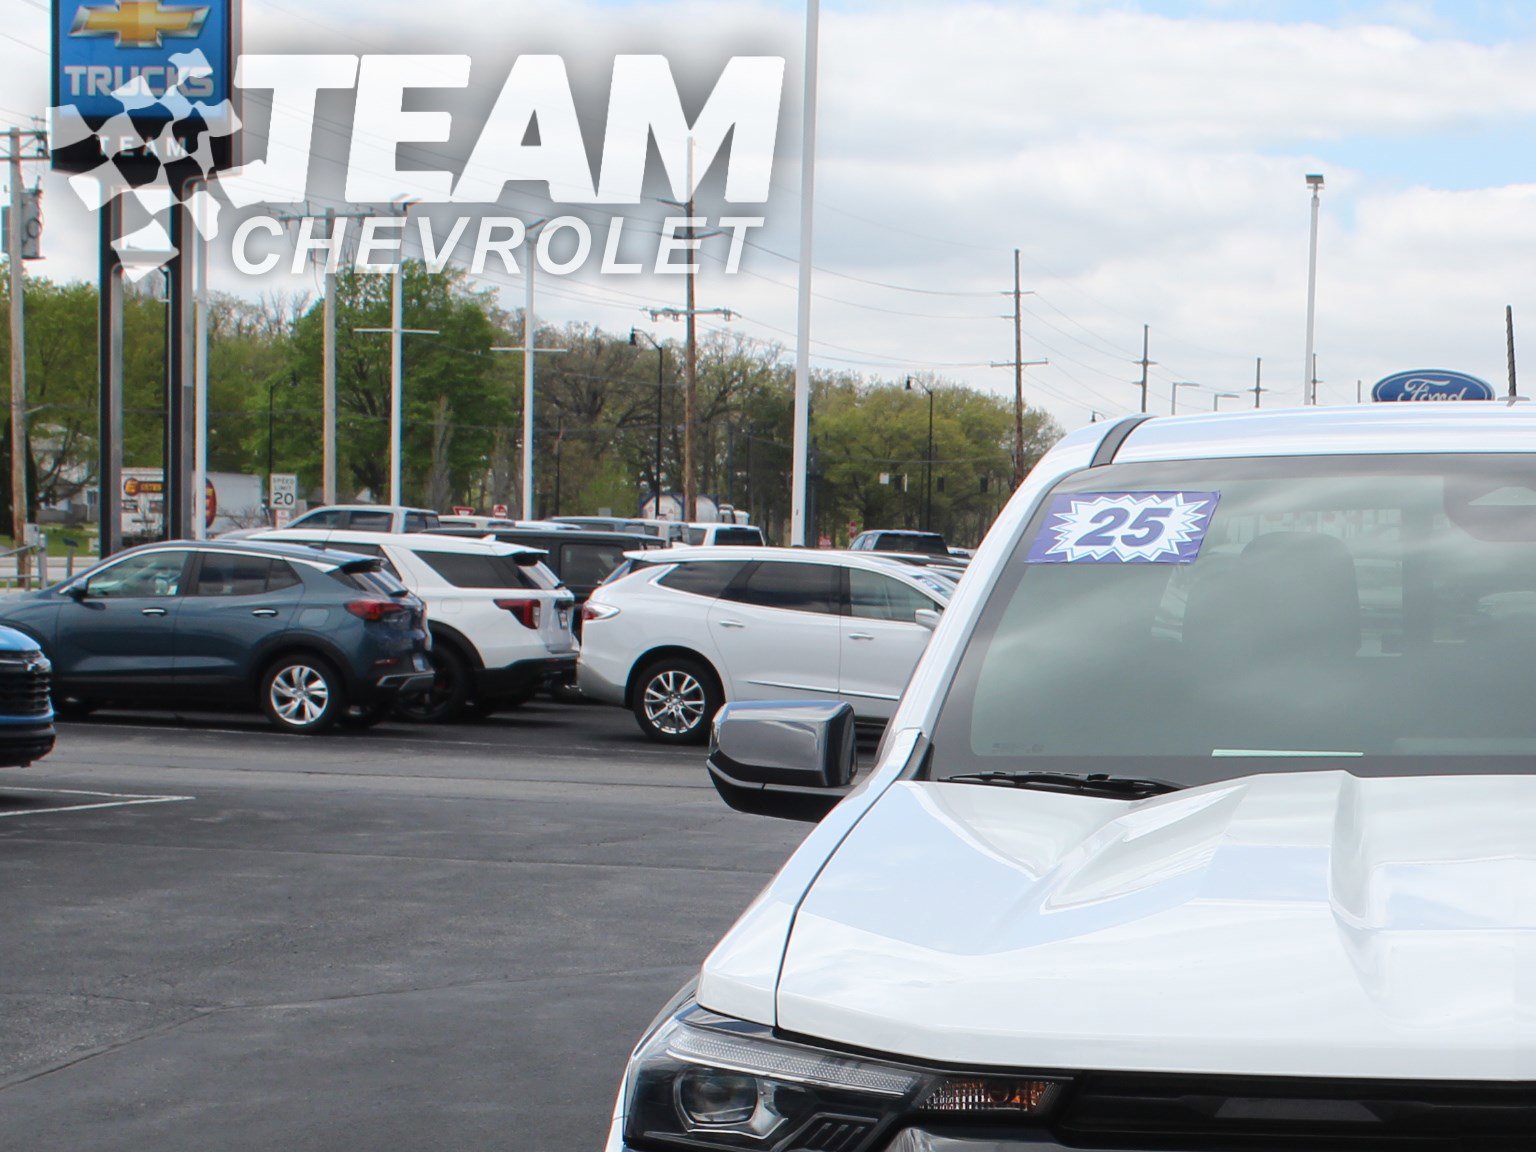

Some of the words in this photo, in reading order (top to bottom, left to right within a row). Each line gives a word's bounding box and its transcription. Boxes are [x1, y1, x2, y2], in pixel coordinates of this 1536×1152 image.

[64, 65, 215, 97] TRUCKS
[97, 136, 187, 157] TEAM
[1397, 377, 1467, 401] Ford
[273, 492, 294, 505] 20
[1074, 507, 1174, 547] 25
